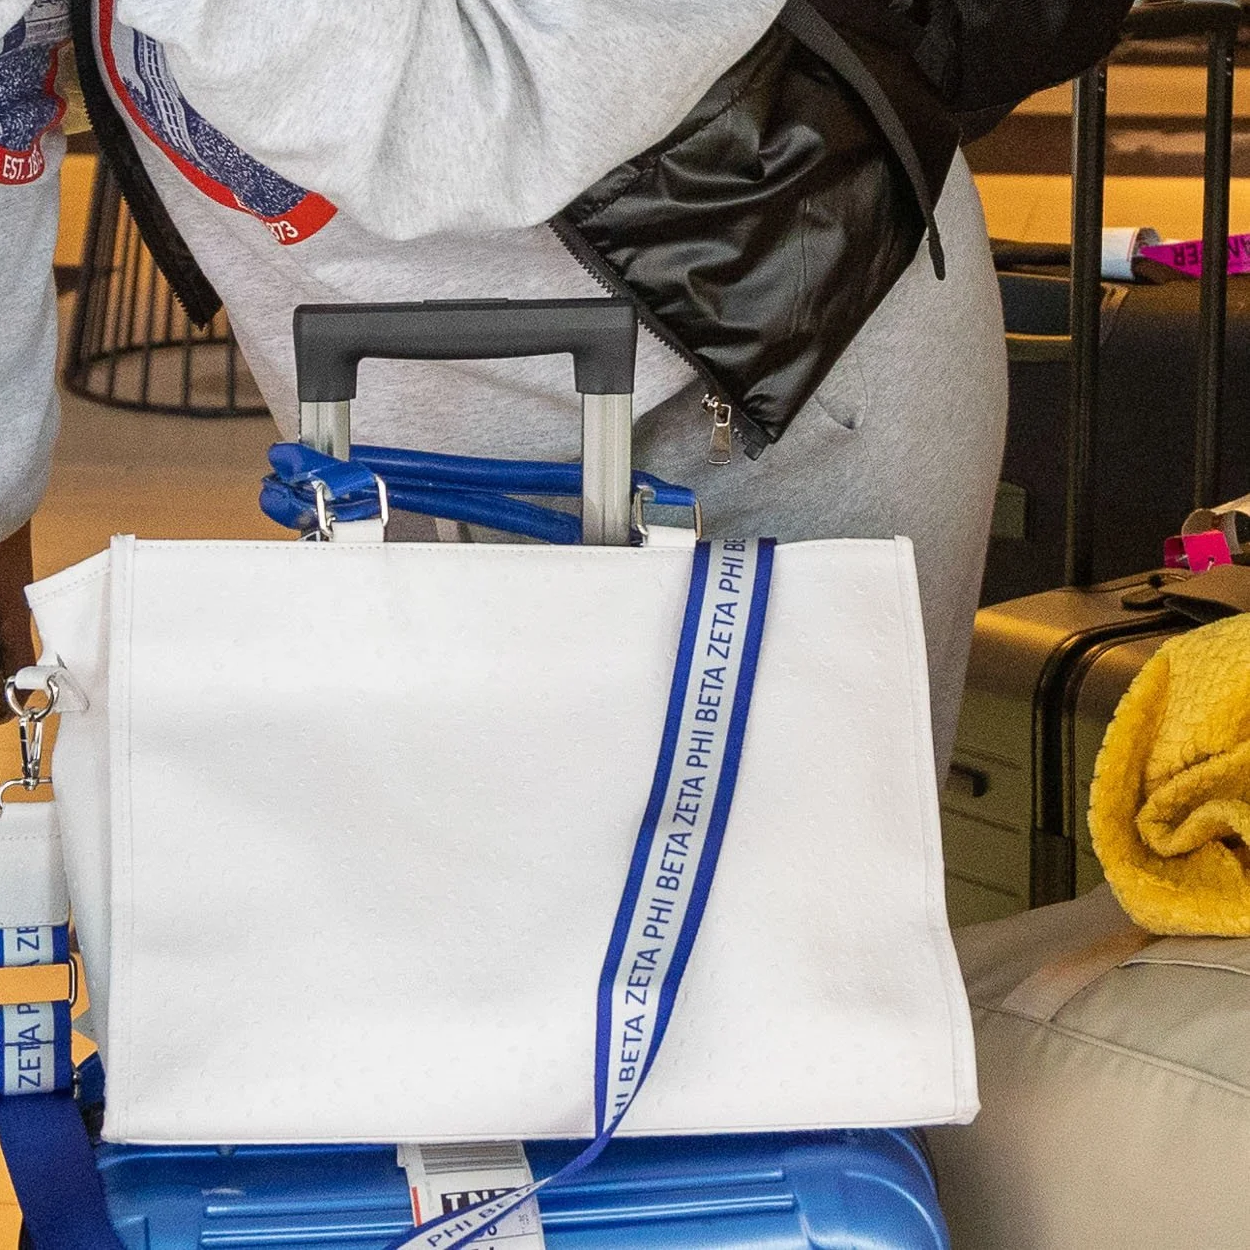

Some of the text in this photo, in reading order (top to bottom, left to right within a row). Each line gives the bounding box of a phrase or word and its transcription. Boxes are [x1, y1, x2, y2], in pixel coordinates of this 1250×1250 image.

[2, 154, 25, 180] EST.
[718, 556, 745, 594] PHI
[706, 602, 739, 661] ZETA
[695, 666, 728, 723] BETA
[686, 730, 714, 769] PHI
[672, 775, 707, 828] ZETA
[656, 831, 692, 891] BETA
[642, 898, 675, 940] PHI
[625, 947, 662, 1005] ZETA
[17, 1023, 41, 1089] ZETA
[618, 1014, 646, 1082] BETA
[612, 1092, 629, 1120] HI
[427, 1220, 473, 1248] PHI
